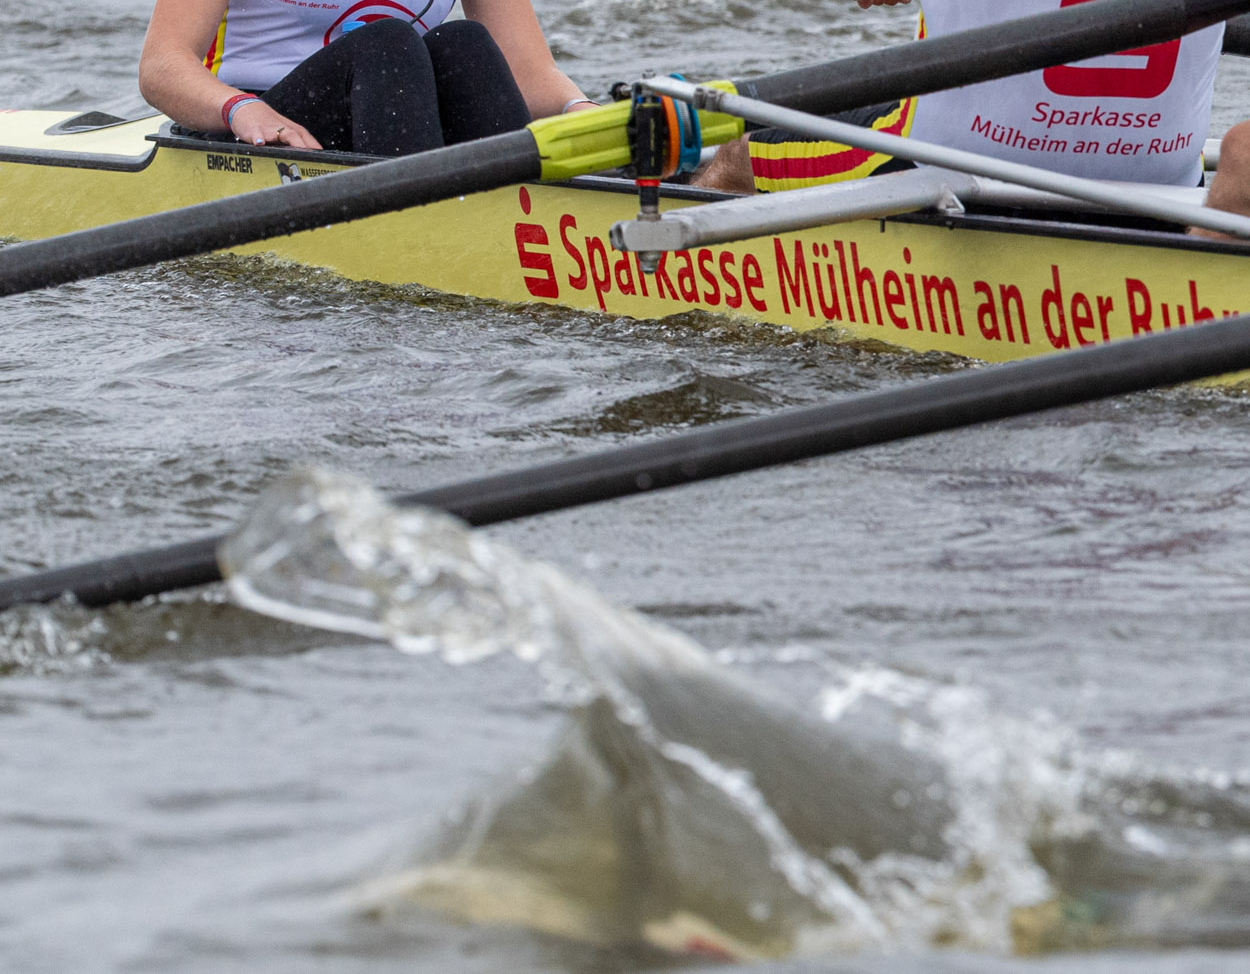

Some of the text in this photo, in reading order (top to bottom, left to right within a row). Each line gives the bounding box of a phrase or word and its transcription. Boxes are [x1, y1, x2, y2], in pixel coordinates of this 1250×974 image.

[308, 1, 321, 9] der
[321, 2, 340, 10] Ruhr
[1031, 102, 1161, 128] Sparkasse
[970, 115, 1194, 155] Mülheim an der Ruhr
[206, 153, 253, 174] EMPACHER
[774, 237, 965, 337] Mülheim
[973, 280, 1031, 344] an
[1041, 264, 1115, 350] der
[1125, 277, 1240, 339] Ruh
